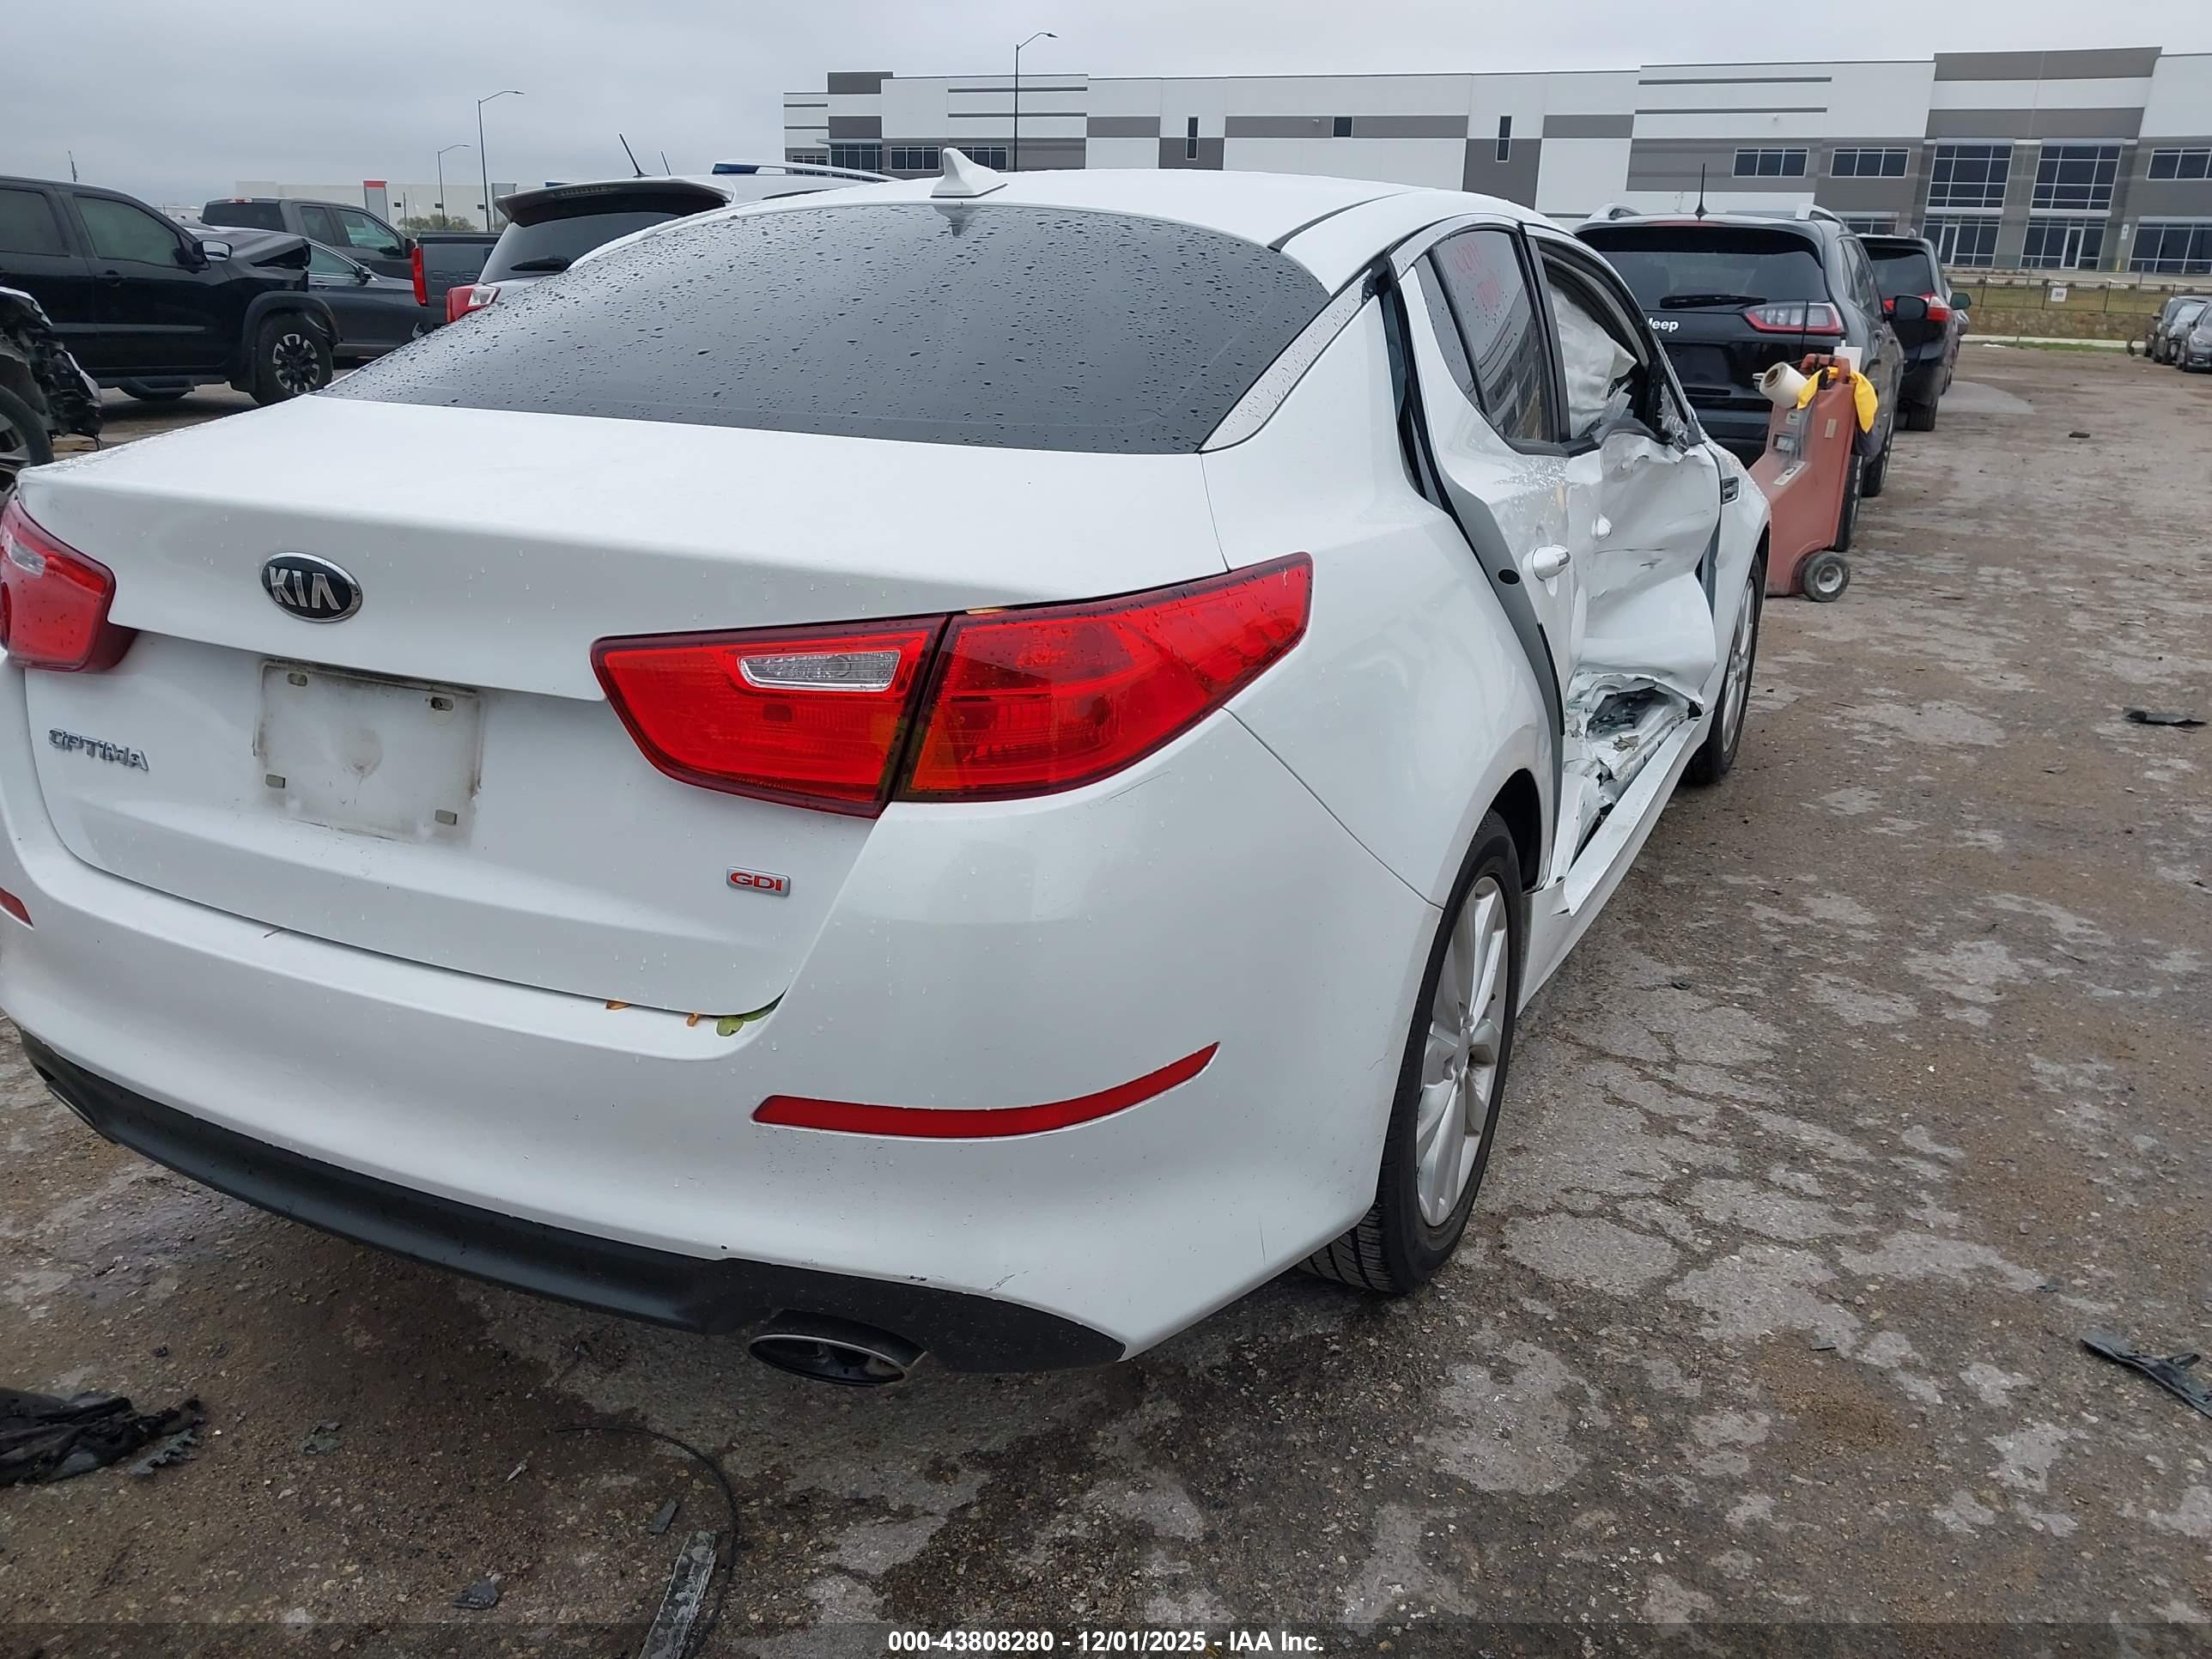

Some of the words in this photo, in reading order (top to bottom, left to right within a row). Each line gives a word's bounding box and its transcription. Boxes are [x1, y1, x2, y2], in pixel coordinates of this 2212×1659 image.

[268, 566, 341, 611] KIA
[48, 728, 149, 771] OPTIMA
[731, 872, 782, 891] GDI
